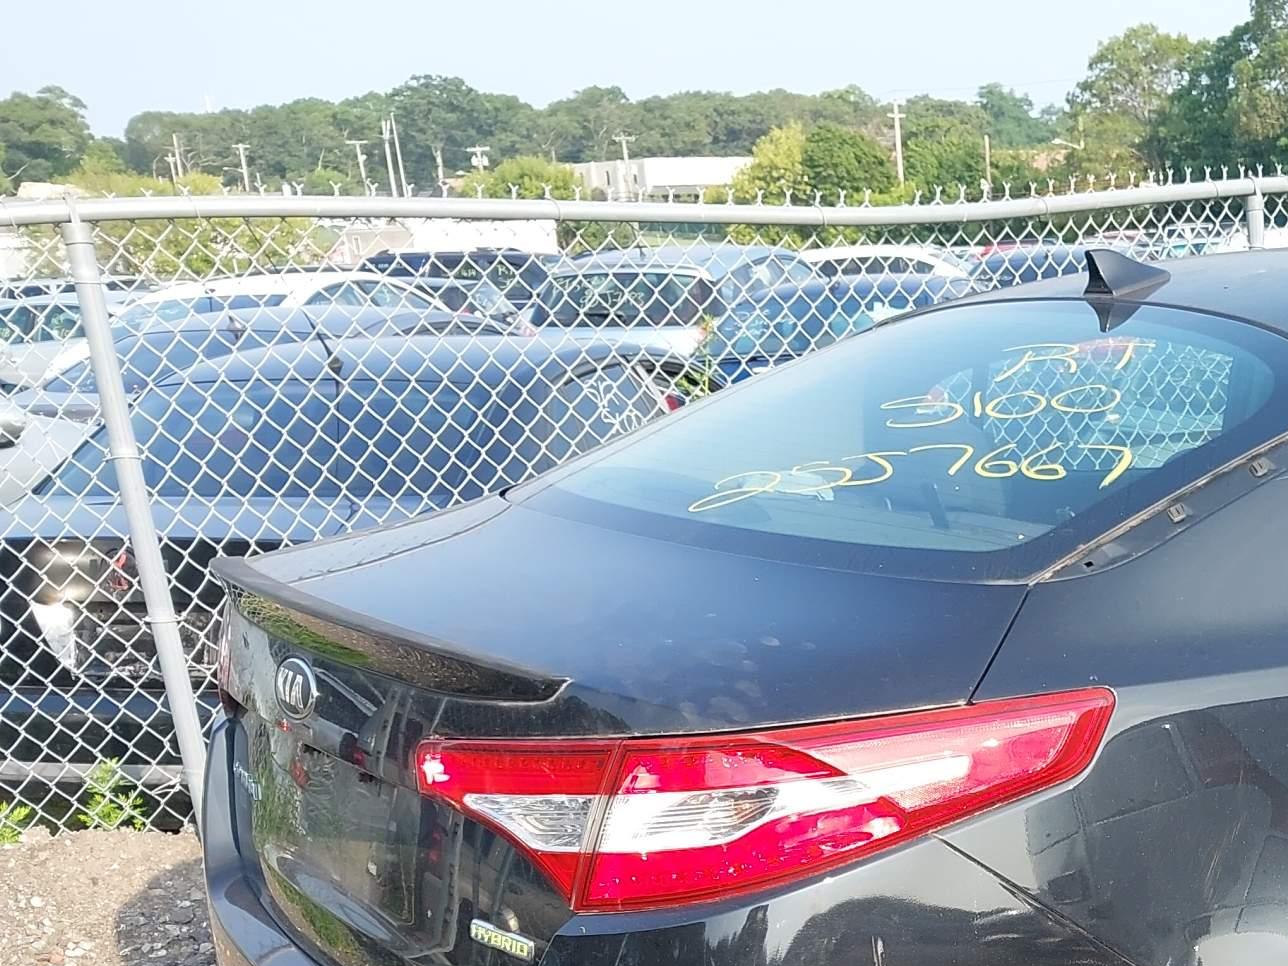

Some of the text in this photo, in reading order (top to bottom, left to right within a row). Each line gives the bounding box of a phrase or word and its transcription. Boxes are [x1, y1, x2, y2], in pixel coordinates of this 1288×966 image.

[994, 343, 1156, 383] RT
[277, 665, 304, 710] KIA
[469, 924, 529, 957] HYBRID
